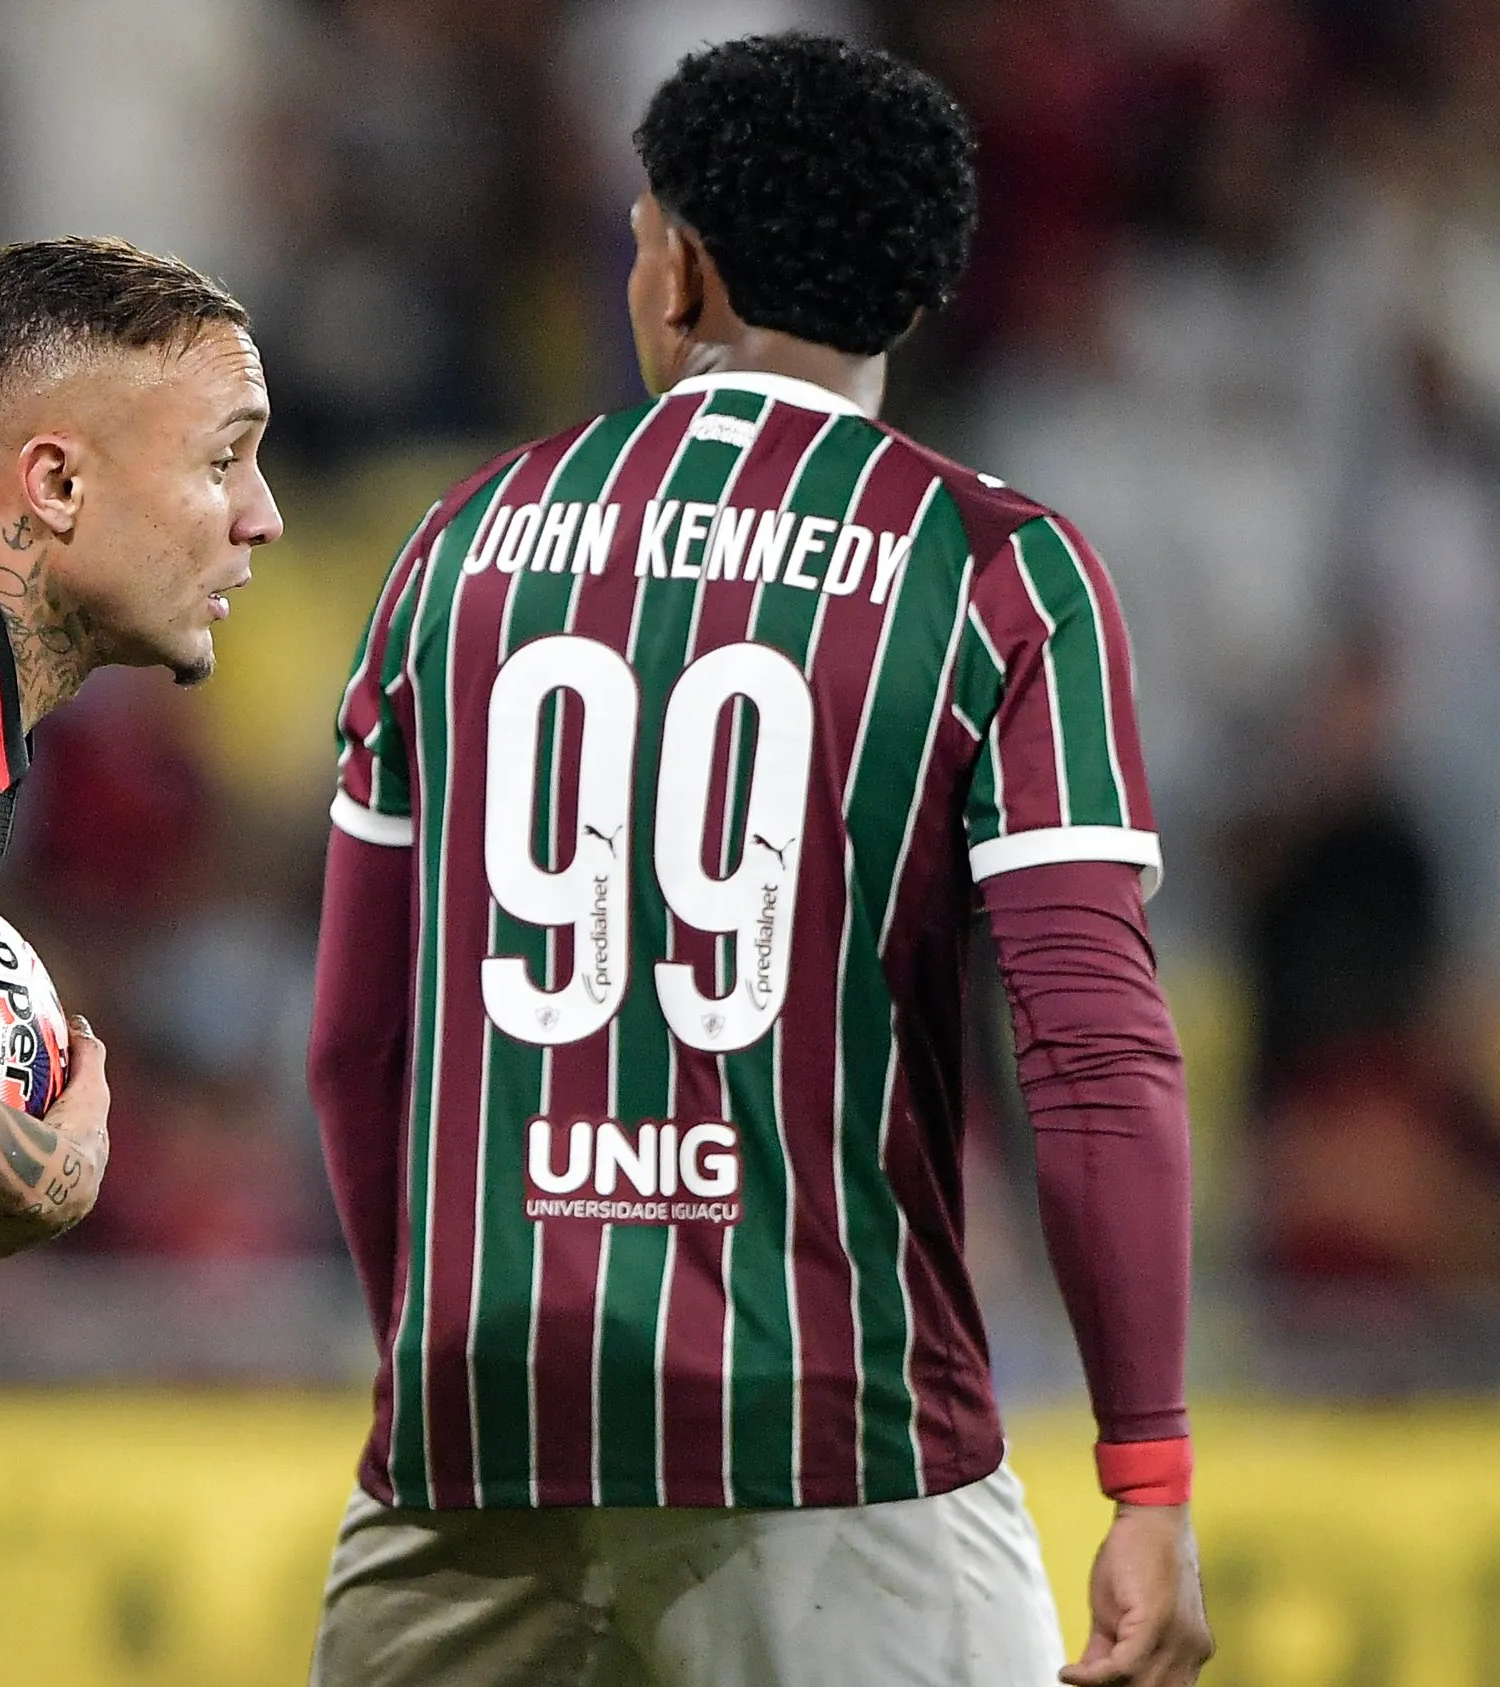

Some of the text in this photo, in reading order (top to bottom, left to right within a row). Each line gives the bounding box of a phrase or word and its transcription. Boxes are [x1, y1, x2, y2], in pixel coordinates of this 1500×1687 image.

[462, 500, 911, 604] JOHN KENNEDY
[481, 634, 814, 1052] 99
[589, 875, 612, 988] predialnet
[753, 883, 779, 994] predialnet
[526, 1200, 739, 1223] UNIVERSIDADE IGUAÇU
[528, 1119, 739, 1198] UNIG
